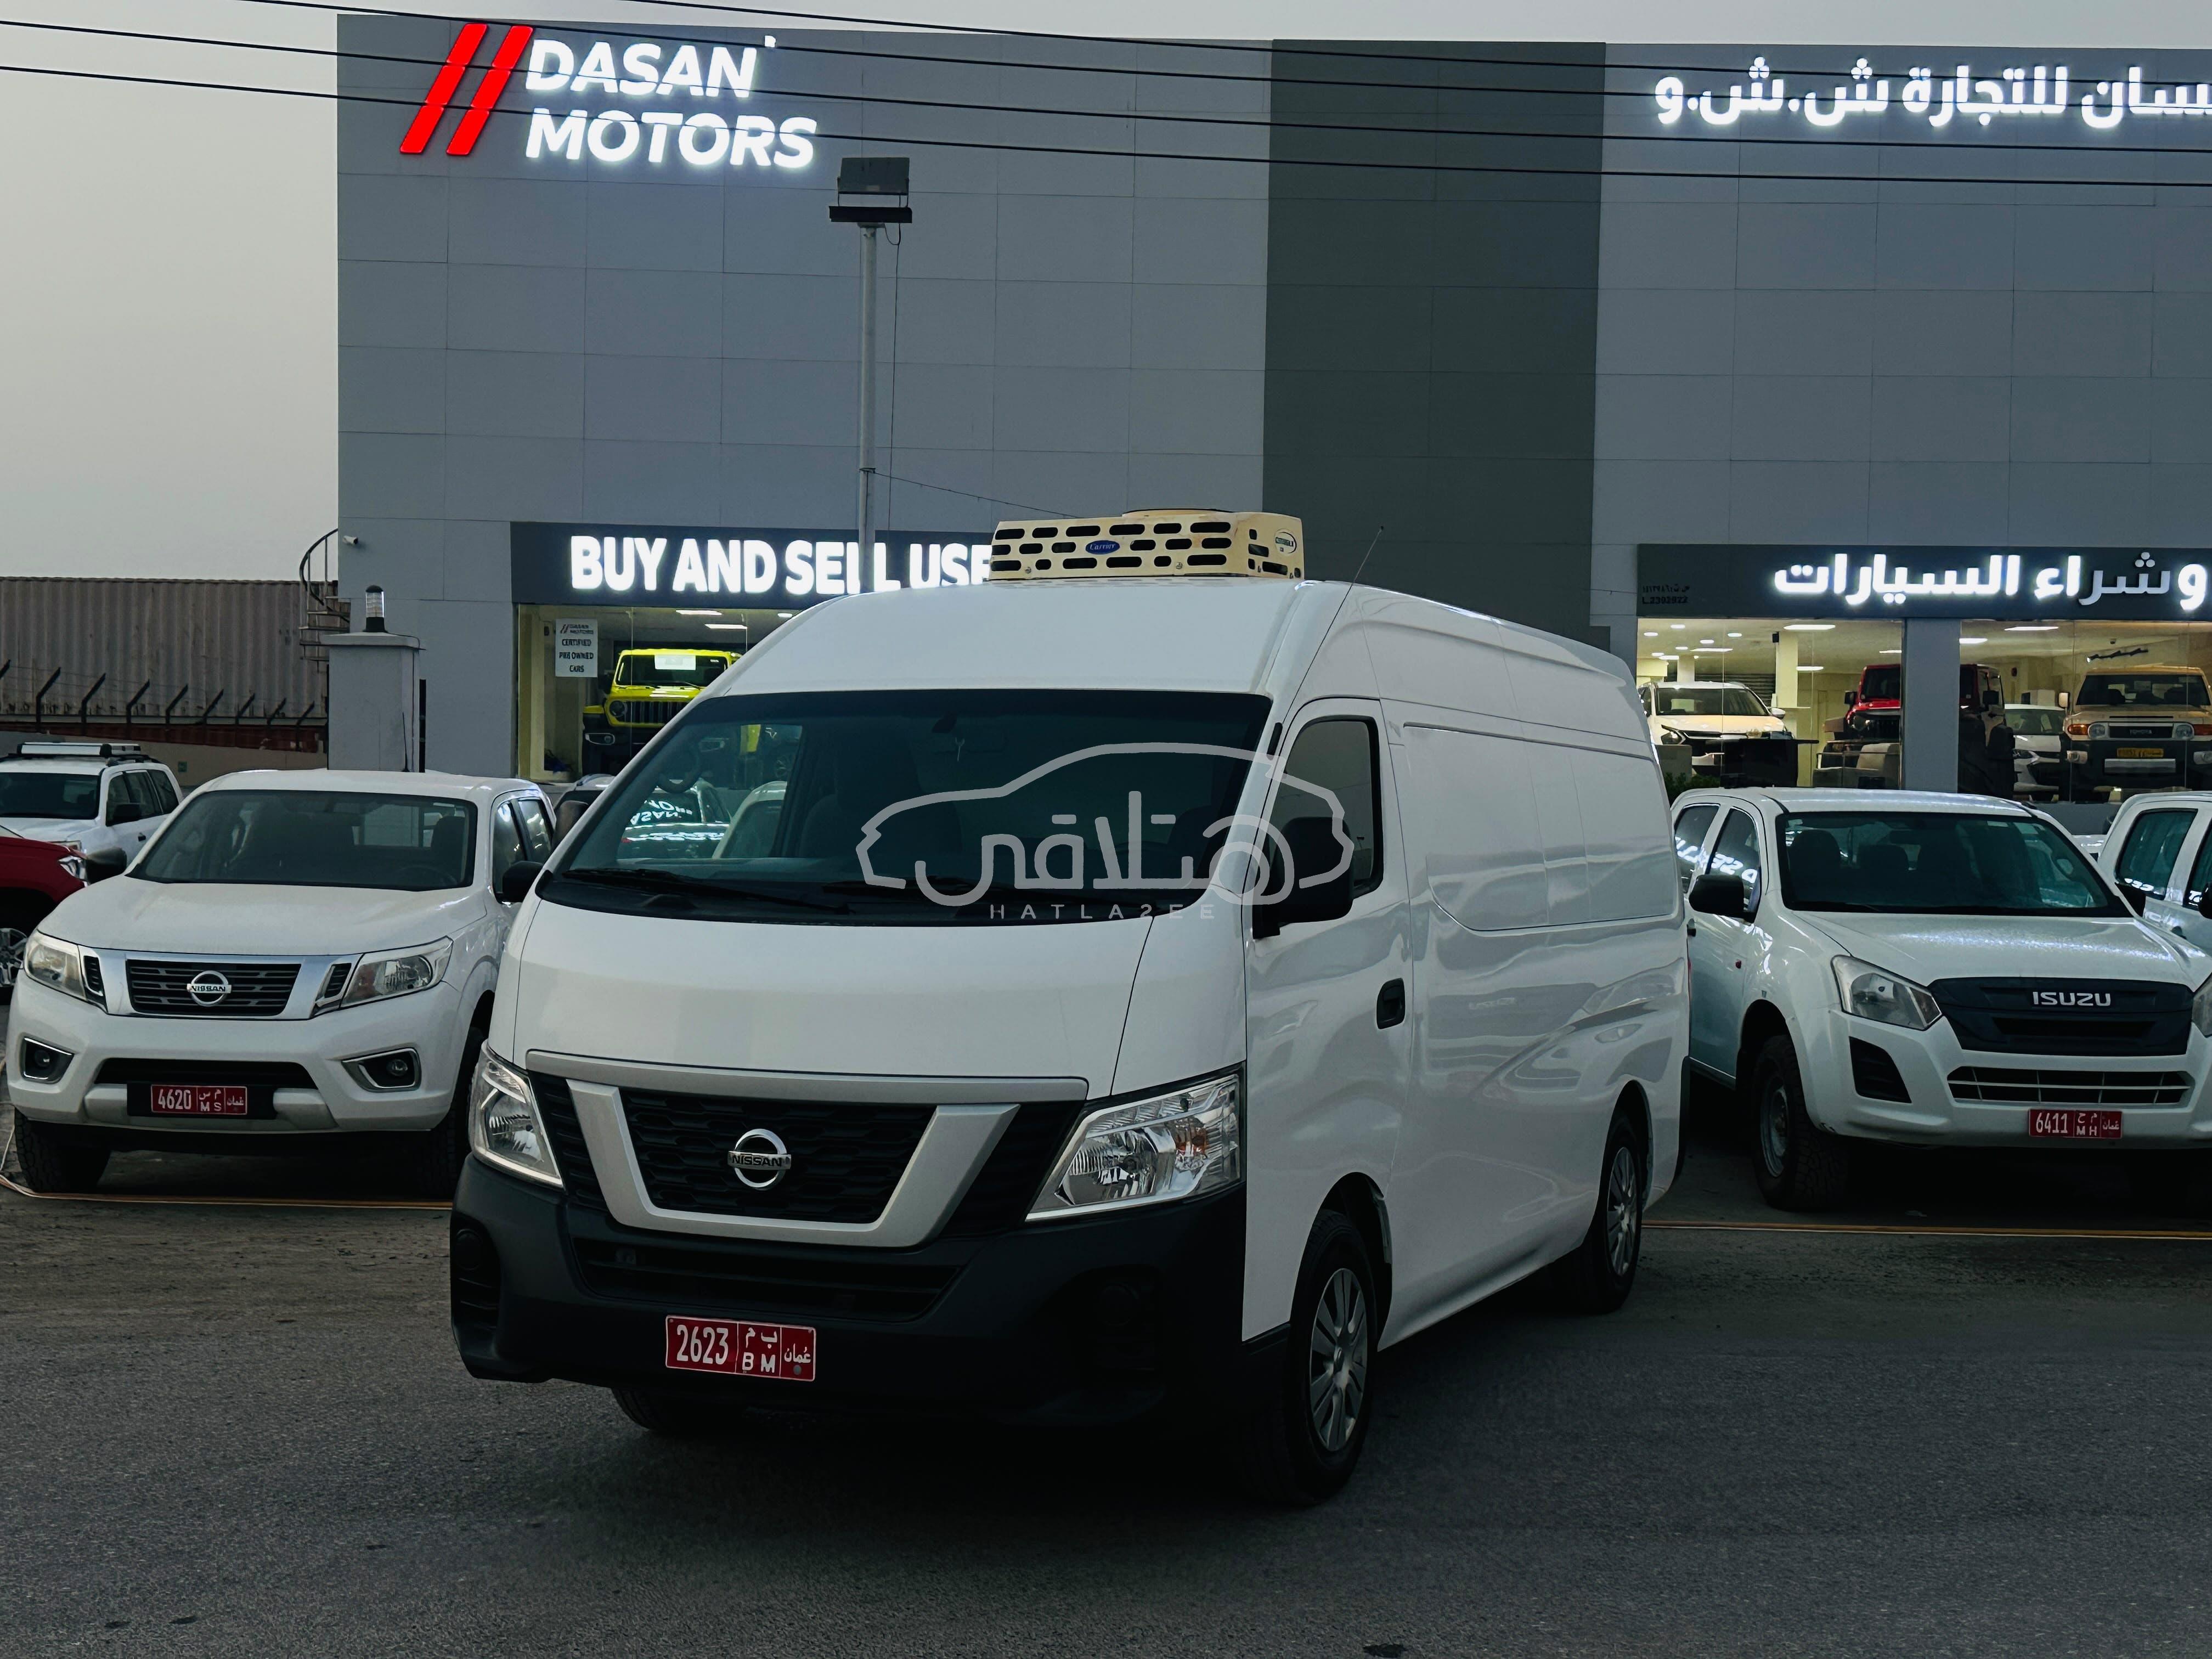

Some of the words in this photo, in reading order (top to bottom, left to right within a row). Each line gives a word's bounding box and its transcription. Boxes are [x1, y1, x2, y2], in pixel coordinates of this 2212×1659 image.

[526, 40, 757, 98] DASAN
[1901, 65, 2067, 127] للتجارة
[526, 108, 817, 168] MOTORS
[571, 535, 667, 591] BUY
[673, 539, 777, 592] AND
[909, 543, 993, 589] USE
[1774, 553, 2021, 605] السيارات
[2032, 991, 2111, 1007] ISUZU
[157, 1088, 191, 1110] 4620
[2036, 1112, 2068, 1133] 6411
[732, 1154, 782, 1167] NISSAN
[676, 1324, 729, 1365] 2623
